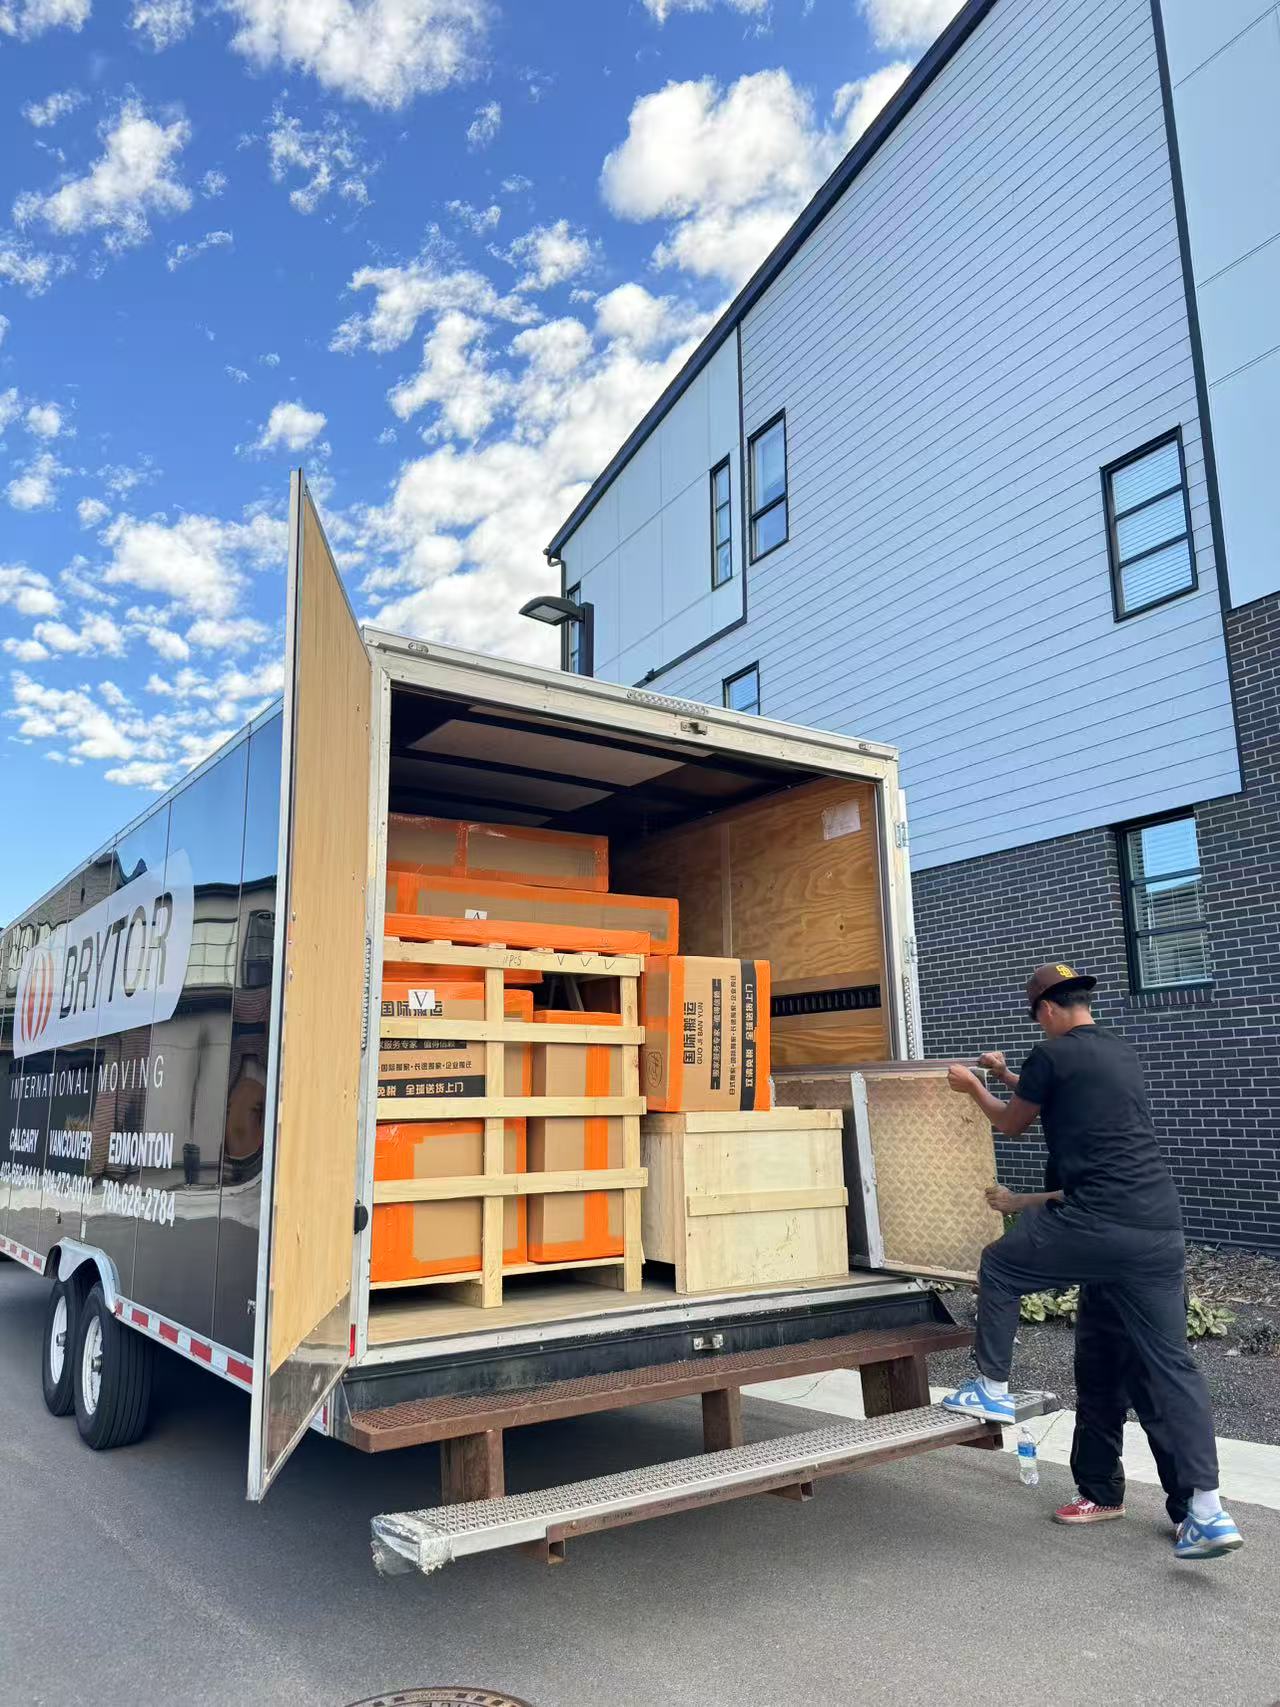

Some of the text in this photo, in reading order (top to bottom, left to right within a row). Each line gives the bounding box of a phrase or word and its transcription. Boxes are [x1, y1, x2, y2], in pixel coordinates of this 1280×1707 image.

[59, 891, 173, 1019] BRYTOR
[414, 991, 427, 1008] V
[745, 983, 754, 1041] 全球送货上门
[683, 1002, 697, 1064] 国际搬运
[10, 1055, 164, 1099] INTERNATIONAL MOVING
[406, 1082, 464, 1096] 全球送货上门
[9, 1128, 174, 1169] CALGARY VANCOUVER EDMONTON
[101, 1179, 176, 1227] 780-628-2784
